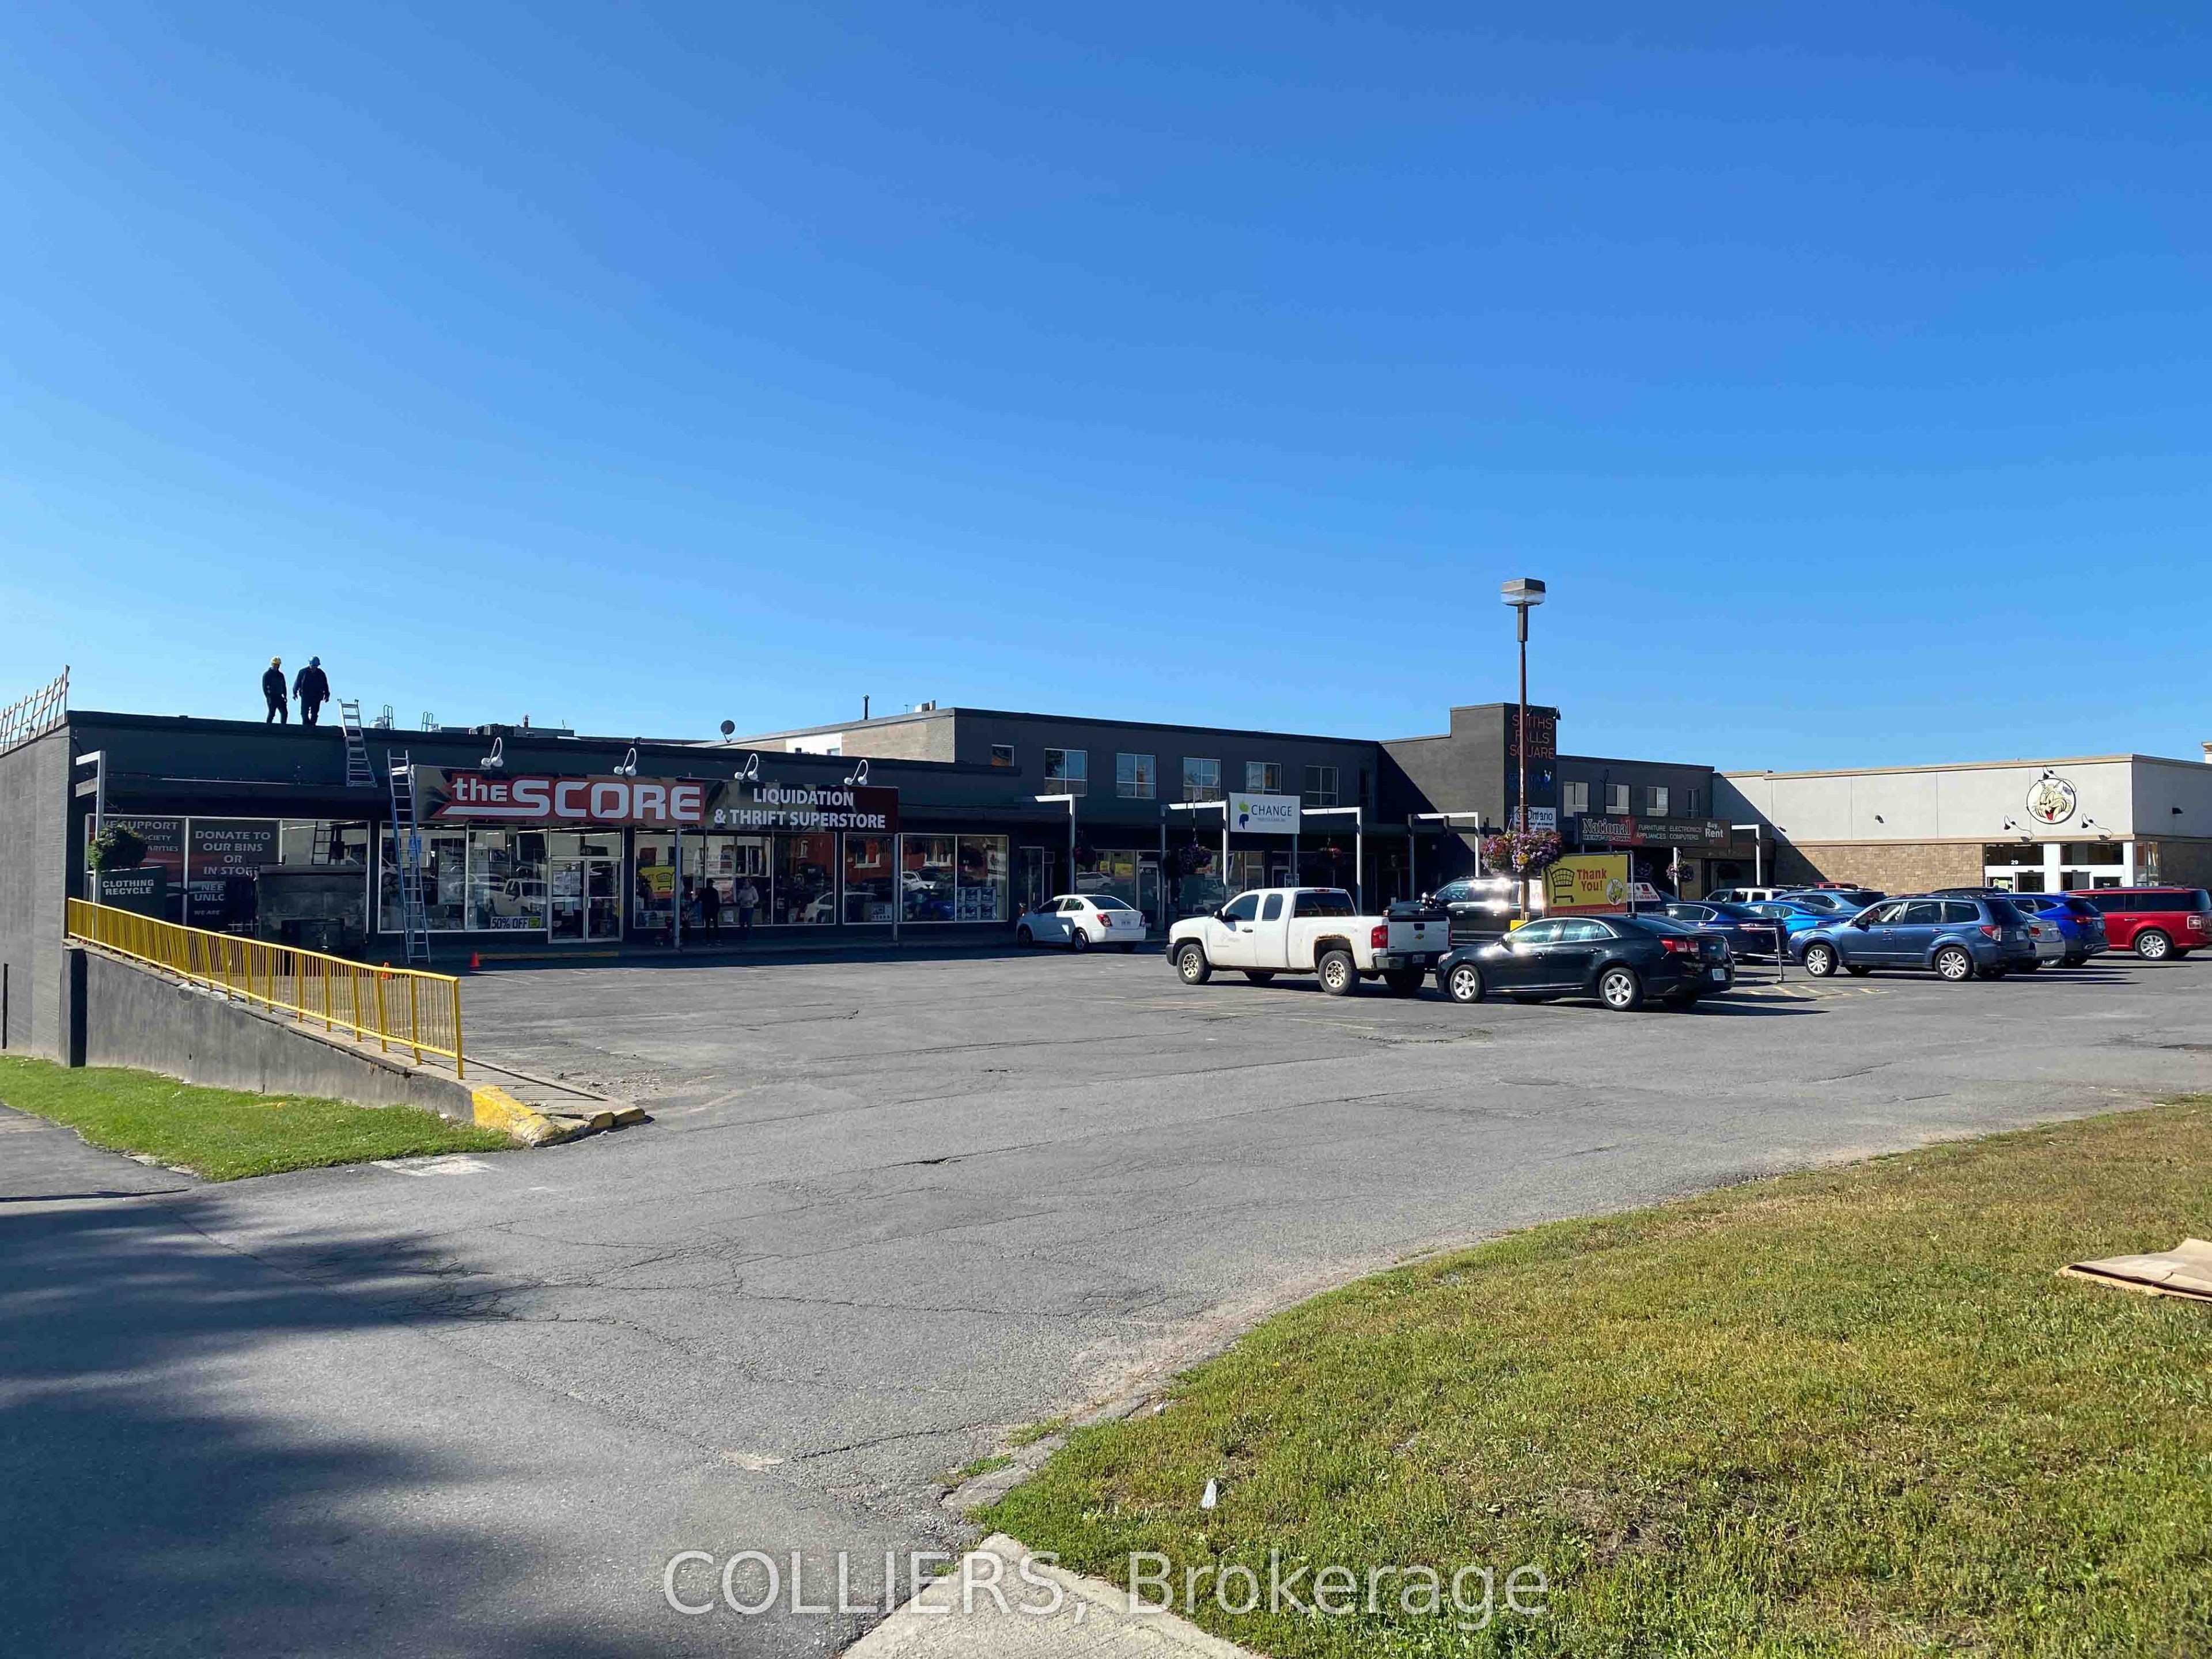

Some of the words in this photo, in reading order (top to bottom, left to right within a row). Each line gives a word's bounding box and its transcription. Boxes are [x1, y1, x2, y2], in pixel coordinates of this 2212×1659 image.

[1512, 715, 1552, 729] SITHS
[1515, 730, 1550, 744] FLLS
[512, 779, 700, 821] SCORE
[753, 787, 854, 806] LIQUIDATION
[1251, 804, 1292, 816] CHANGE
[714, 808, 726, 824] &
[729, 809, 786, 825] THRIFT
[790, 811, 886, 828] SUPERSTORE
[1582, 818, 1631, 835] National
[195, 831, 250, 840] DONATE
[253, 832, 271, 840] TO
[1705, 828, 1724, 838] Rent
[202, 843, 231, 851] OUR
[234, 843, 263, 852] BINS
[224, 855, 243, 863] OR
[203, 866, 217, 875] IN
[1577, 868, 1607, 880] Thank
[102, 880, 154, 888] CLOTHING
[1581, 880, 1603, 892] You!
[105, 887, 152, 895] RECYCLE
[491, 918, 510, 929] 50%
[512, 918, 528, 929] OFF
